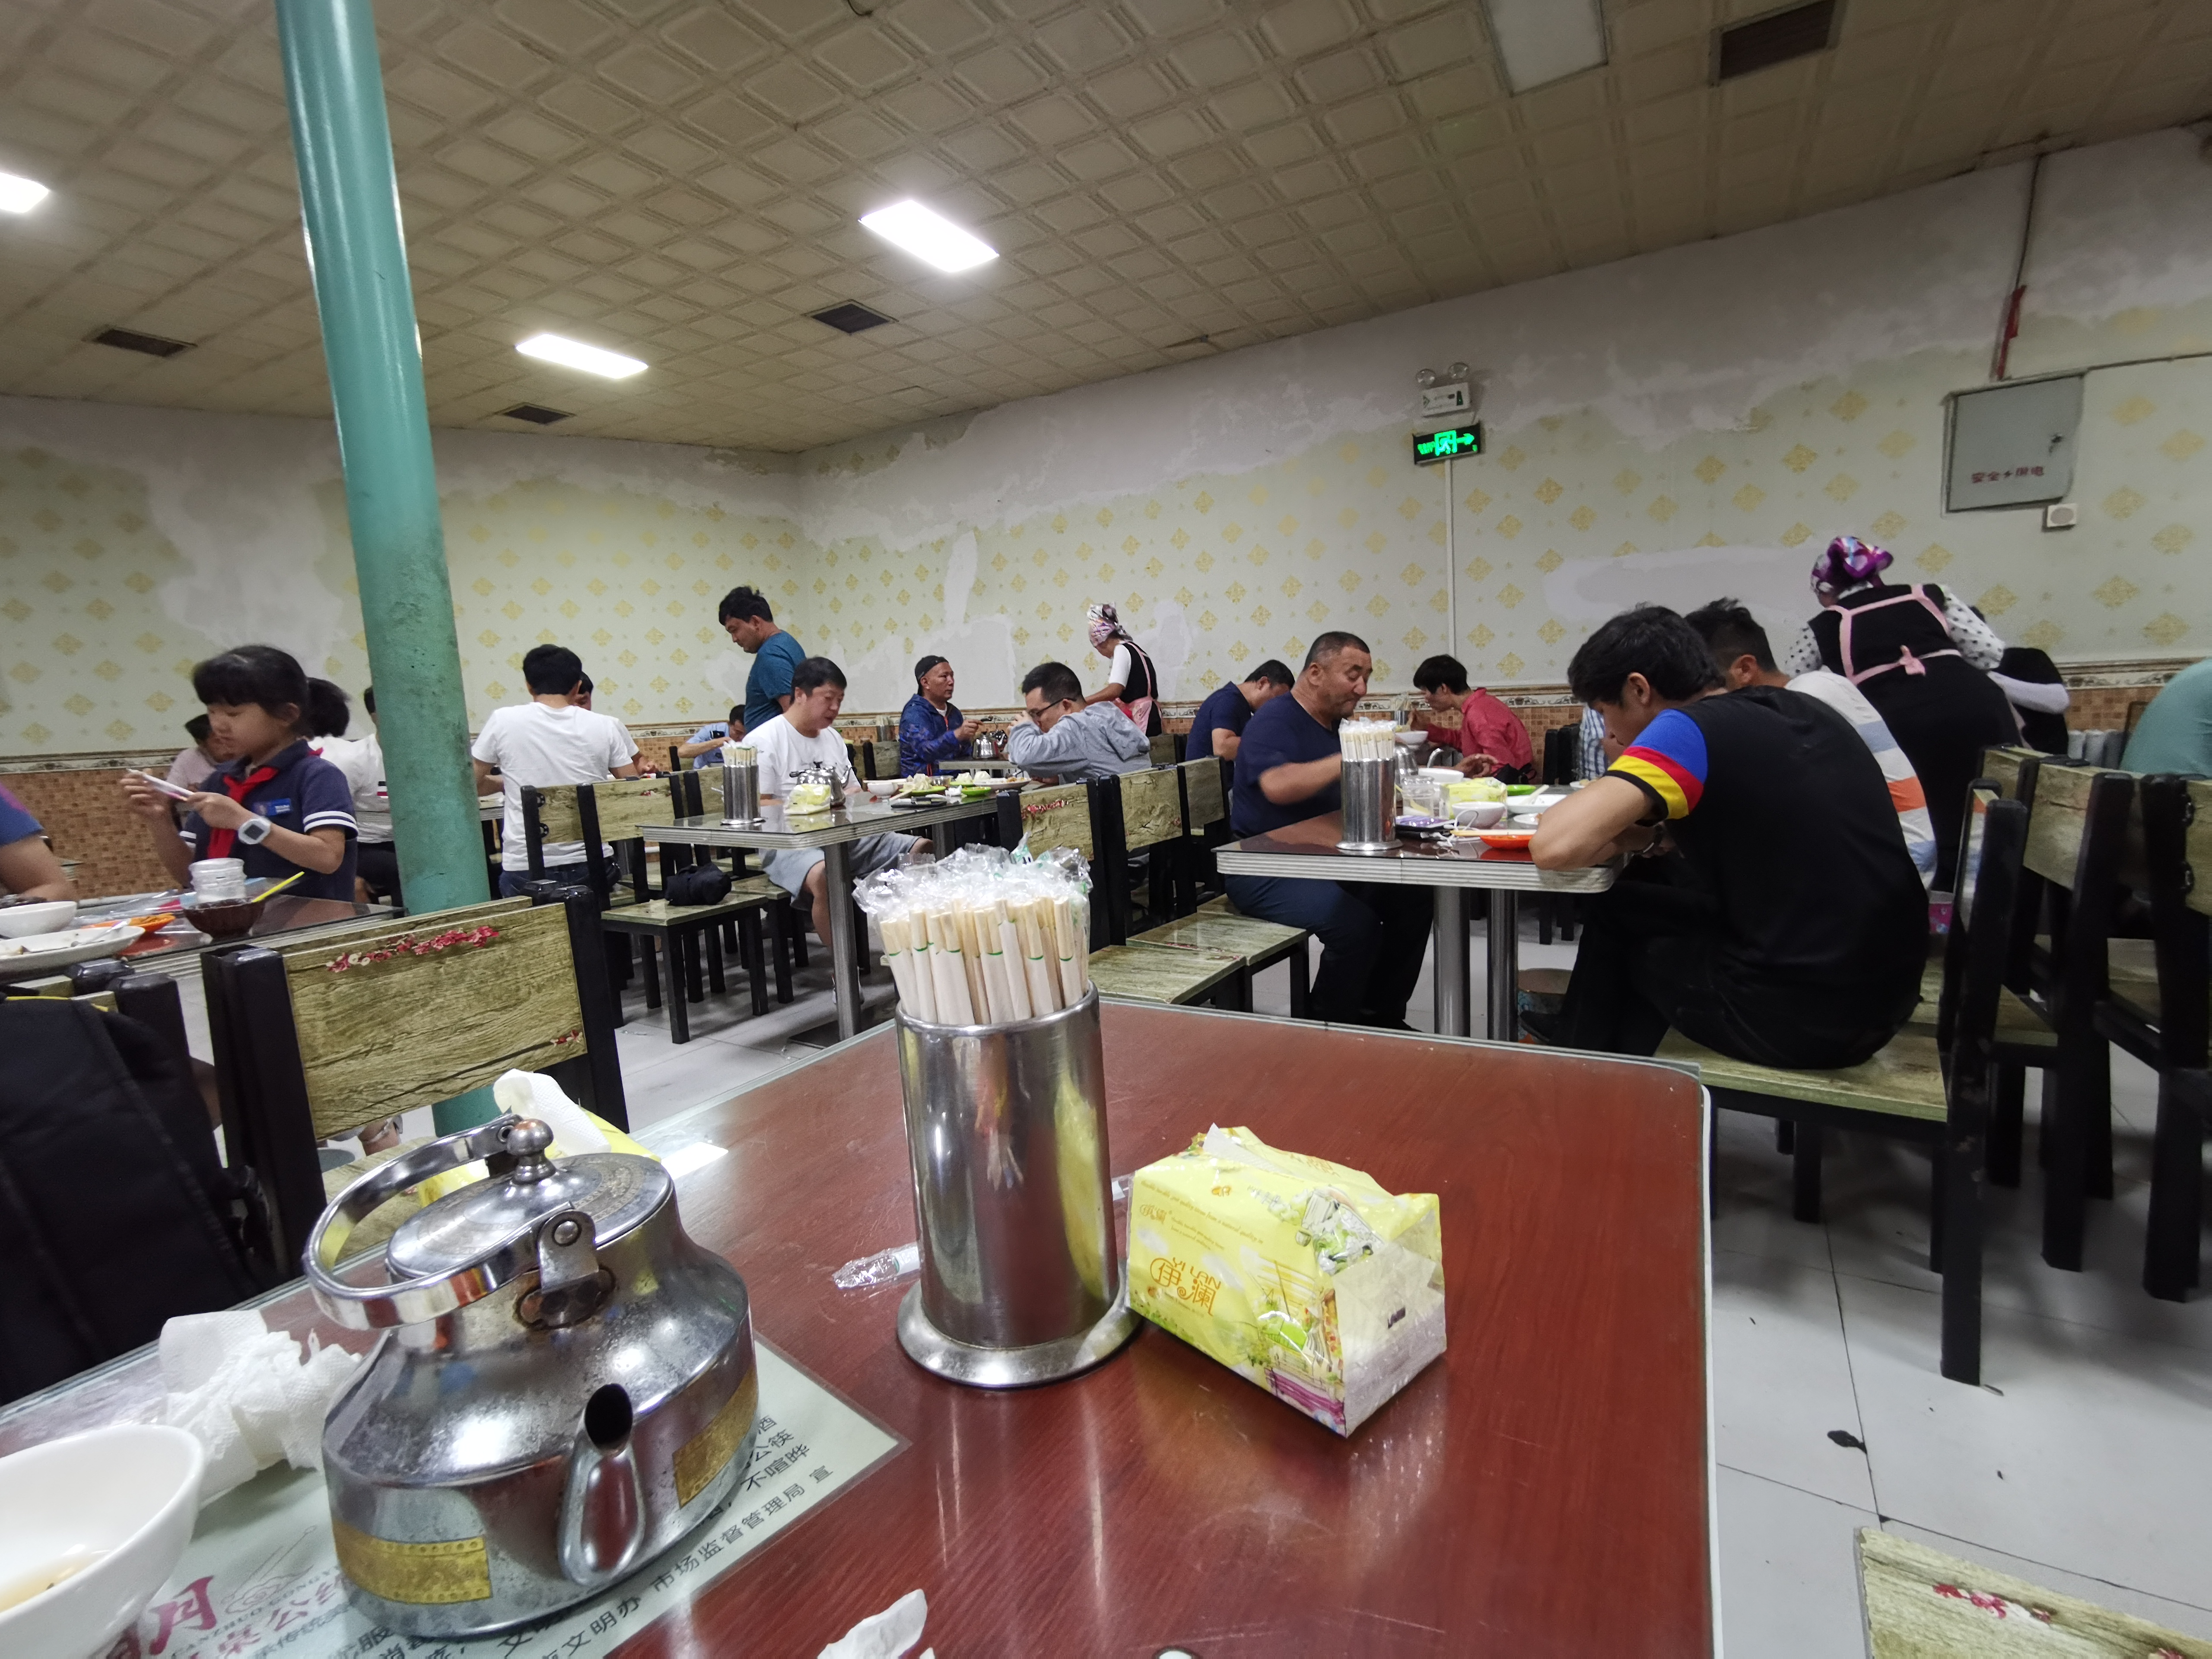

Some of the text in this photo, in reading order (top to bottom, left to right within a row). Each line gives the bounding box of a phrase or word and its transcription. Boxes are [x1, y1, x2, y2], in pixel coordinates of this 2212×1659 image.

[1190, 1266, 1221, 1290] LAN
[649, 1483, 805, 1592] 市场监督管理局
